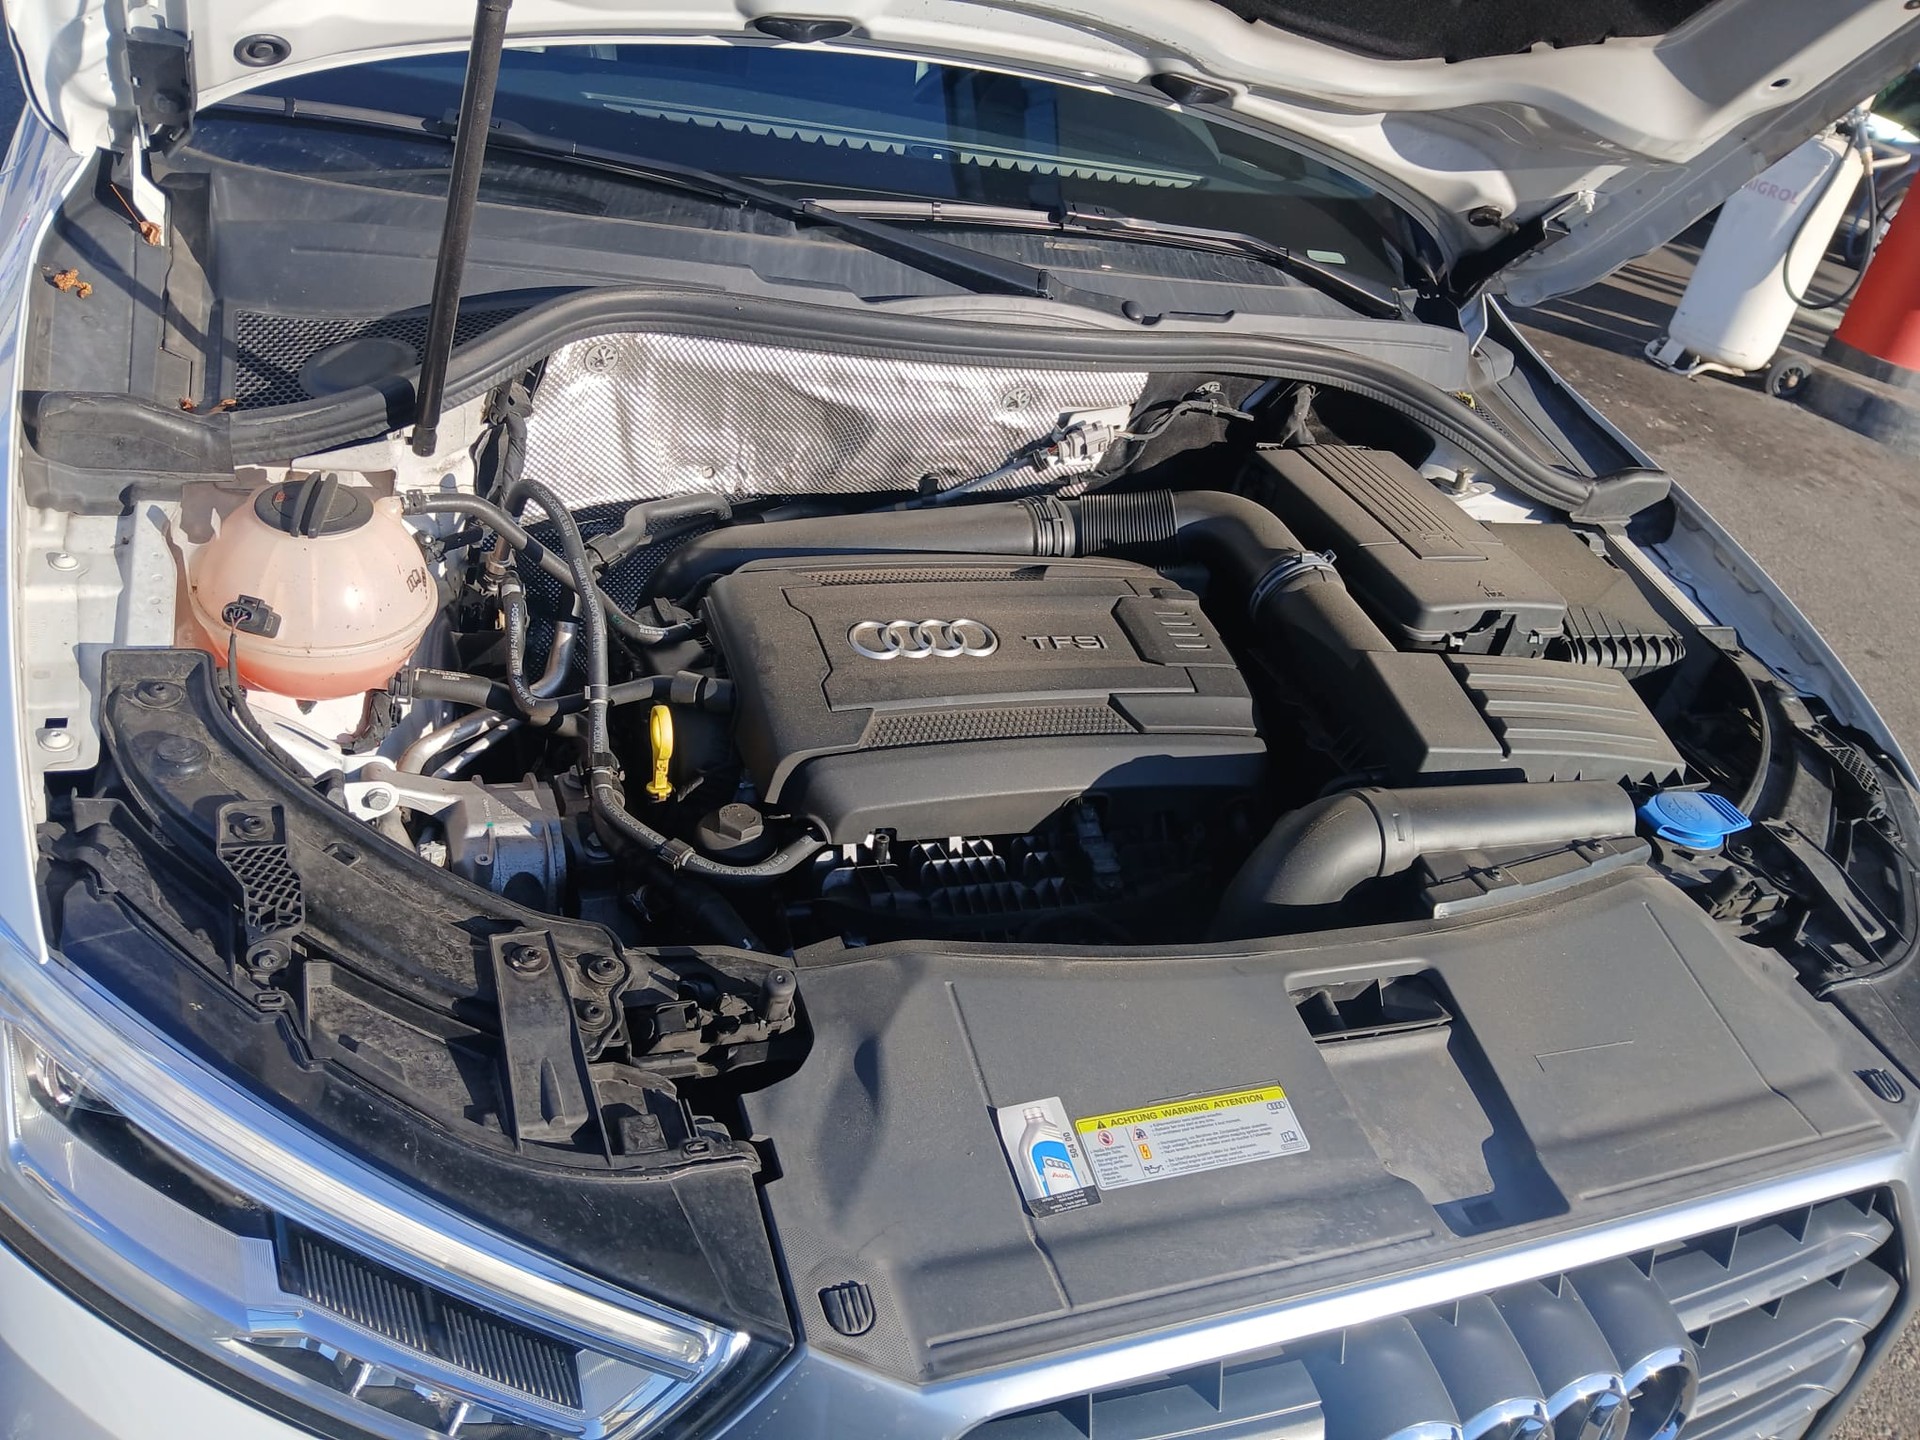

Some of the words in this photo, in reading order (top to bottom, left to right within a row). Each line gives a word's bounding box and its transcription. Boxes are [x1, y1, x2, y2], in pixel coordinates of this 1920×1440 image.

[1023, 634, 1109, 650] TFSI
[1110, 1111, 1158, 1128] ACHTUNG
[1161, 1102, 1210, 1119] WARNING
[1213, 1093, 1264, 1109] ATTENTION
[1067, 1143, 1079, 1159] 504
